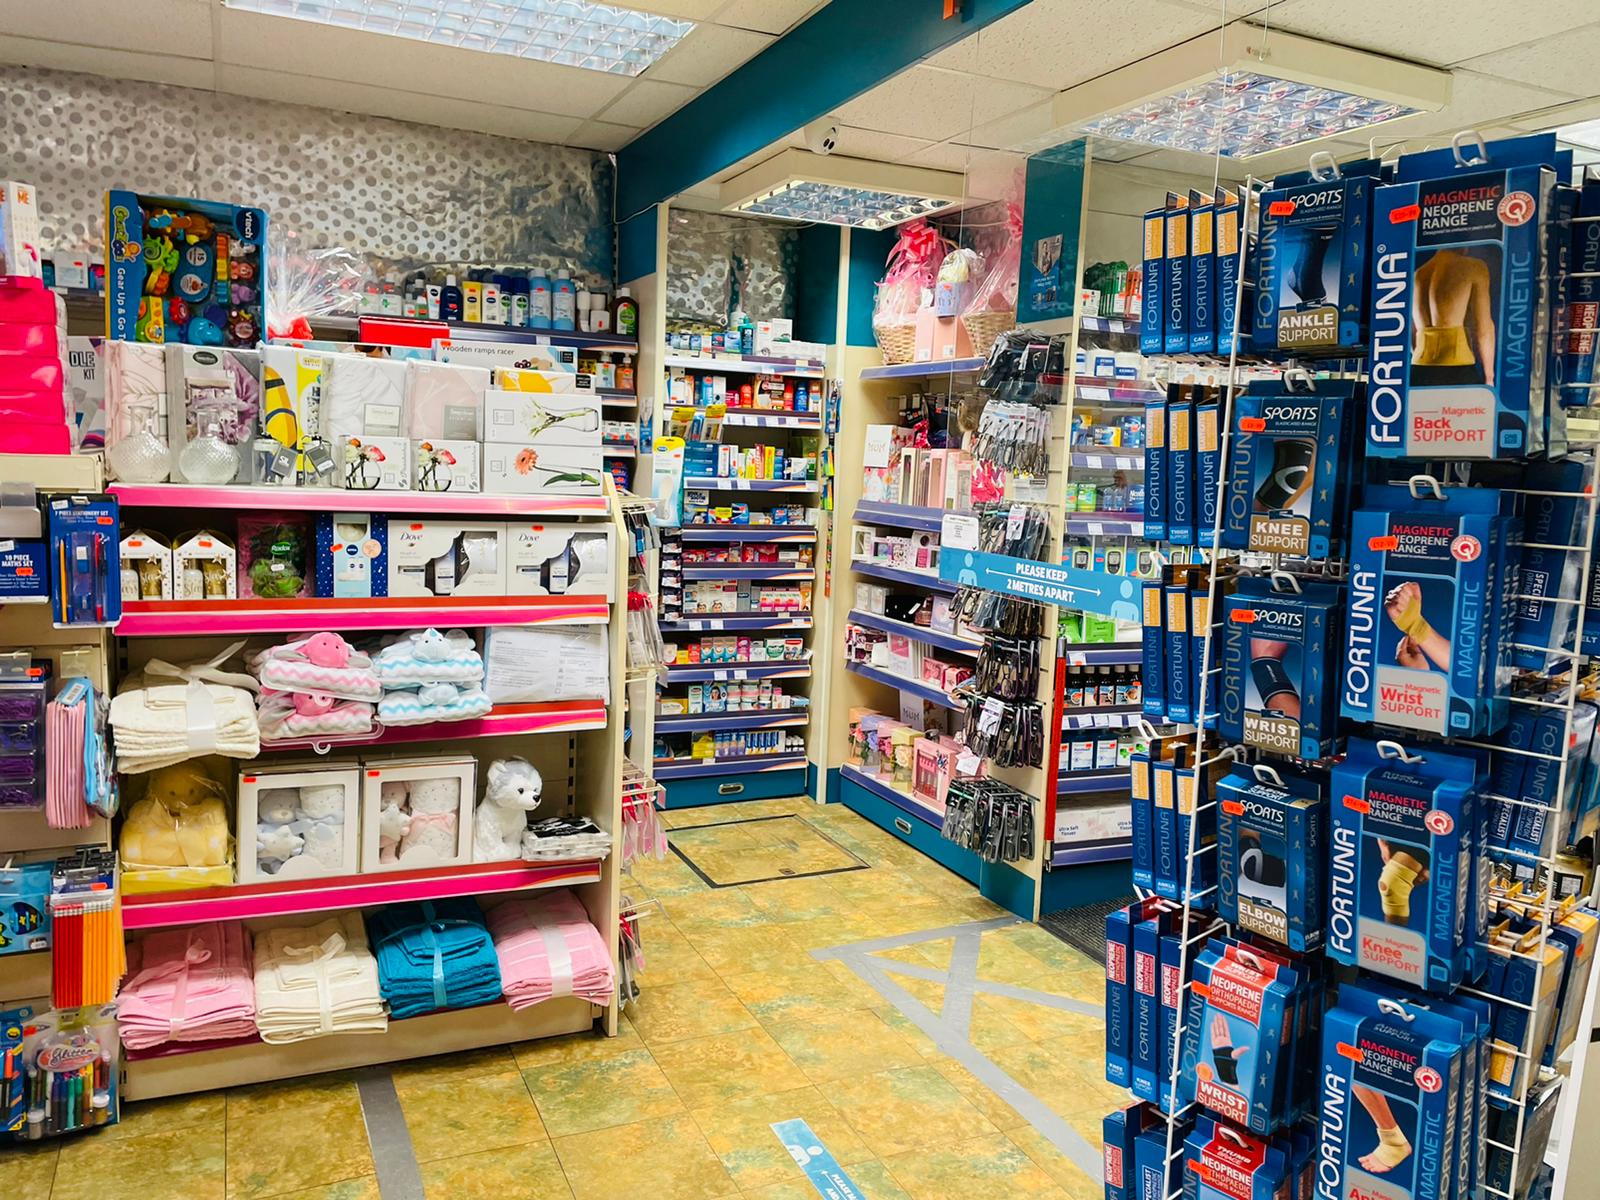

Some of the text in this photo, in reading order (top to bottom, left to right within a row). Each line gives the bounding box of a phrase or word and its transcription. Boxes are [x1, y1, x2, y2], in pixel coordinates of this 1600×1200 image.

[1289, 189, 1344, 208] SPORTS
[1424, 185, 1500, 205] MAGNETIC
[1423, 199, 1494, 217] NEOPRENE
[1422, 214, 1468, 230] RANGE
[117, 268, 125, 290] Gear
[117, 293, 126, 306] Up
[1148, 262, 1158, 331] FORTUNA
[1172, 260, 1182, 329] FORTUNA
[1196, 257, 1207, 328] FORTUNA
[1223, 258, 1234, 330] FORTUNA
[118, 317, 126, 331] Go
[1279, 313, 1334, 328] ANKLE
[1506, 251, 1531, 378] MAGNETIC
[1279, 327, 1335, 342] SUPPORT
[442, 345, 472, 353] Wooden
[474, 347, 495, 355] ramps
[83, 369, 94, 380] KIT
[1263, 407, 1318, 420] SPORTS
[1441, 406, 1486, 415] Magnetic
[1414, 417, 1451, 429] Back
[1413, 429, 1486, 442] SUPPORT
[1150, 451, 1159, 517] FORTUNA
[1229, 421, 1254, 530] FORTUN
[1175, 453, 1185, 521] FORTUNA
[1204, 454, 1214, 523] FORTUNA
[1256, 521, 1303, 536] KNEE
[1392, 525, 1454, 537] MAGNETIC
[1251, 535, 1307, 550] SUPPORT
[1393, 535, 1448, 546] NEOPRENE
[1016, 563, 1068, 581] PLEASE KEEP
[1007, 579, 1076, 603] 2 METRES APART.
[1528, 573, 1544, 618] SPECILIST
[1253, 609, 1303, 626] SPORTS
[1457, 581, 1480, 678] MAGNETIC
[1173, 635, 1182, 700] FORTUNA
[1380, 686, 1424, 705] Wrist
[1405, 683, 1441, 695] Magnetic
[1380, 702, 1441, 719] SUPPORT
[1245, 717, 1299, 737] WRIST
[1244, 730, 1298, 749] SUPPORT
[1240, 800, 1284, 822] SPORTS
[1368, 790, 1427, 810] MAGNETIC
[1368, 799, 1423, 818] NEOPRENE
[1369, 809, 1402, 822] RANGE
[1136, 802, 1145, 866] FORTUNA
[1161, 811, 1169, 876] FORTUNA
[1434, 852, 1454, 941] MAGNETIC
[1239, 902, 1286, 927] ELBOW
[1238, 913, 1287, 941] SUPPORT
[1362, 937, 1403, 959] Knee
[1385, 938, 1419, 952] Magnetic
[1108, 942, 1116, 979] NEOPRENE
[1136, 952, 1144, 990] NEOPRENE
[1362, 951, 1420, 974] SUPPORT
[1210, 986, 1259, 1012] ORTHOPAEDIC
[1212, 975, 1261, 1003] NEOPRENE
[1112, 986, 1120, 1047] FORTUNA
[1140, 998, 1148, 1061] FORTUNA
[1361, 1039, 1417, 1065] MAGNETIC
[1361, 1048, 1413, 1073] NEOPRENE
[1200, 1081, 1246, 1110] WRIST
[1198, 1093, 1246, 1124] SUPPORT
[1420, 1110, 1441, 1200] MAGNETIC
[1201, 1156, 1251, 1184] NEOPRENE
[1209, 1169, 1251, 1193] THOPAEDIC
